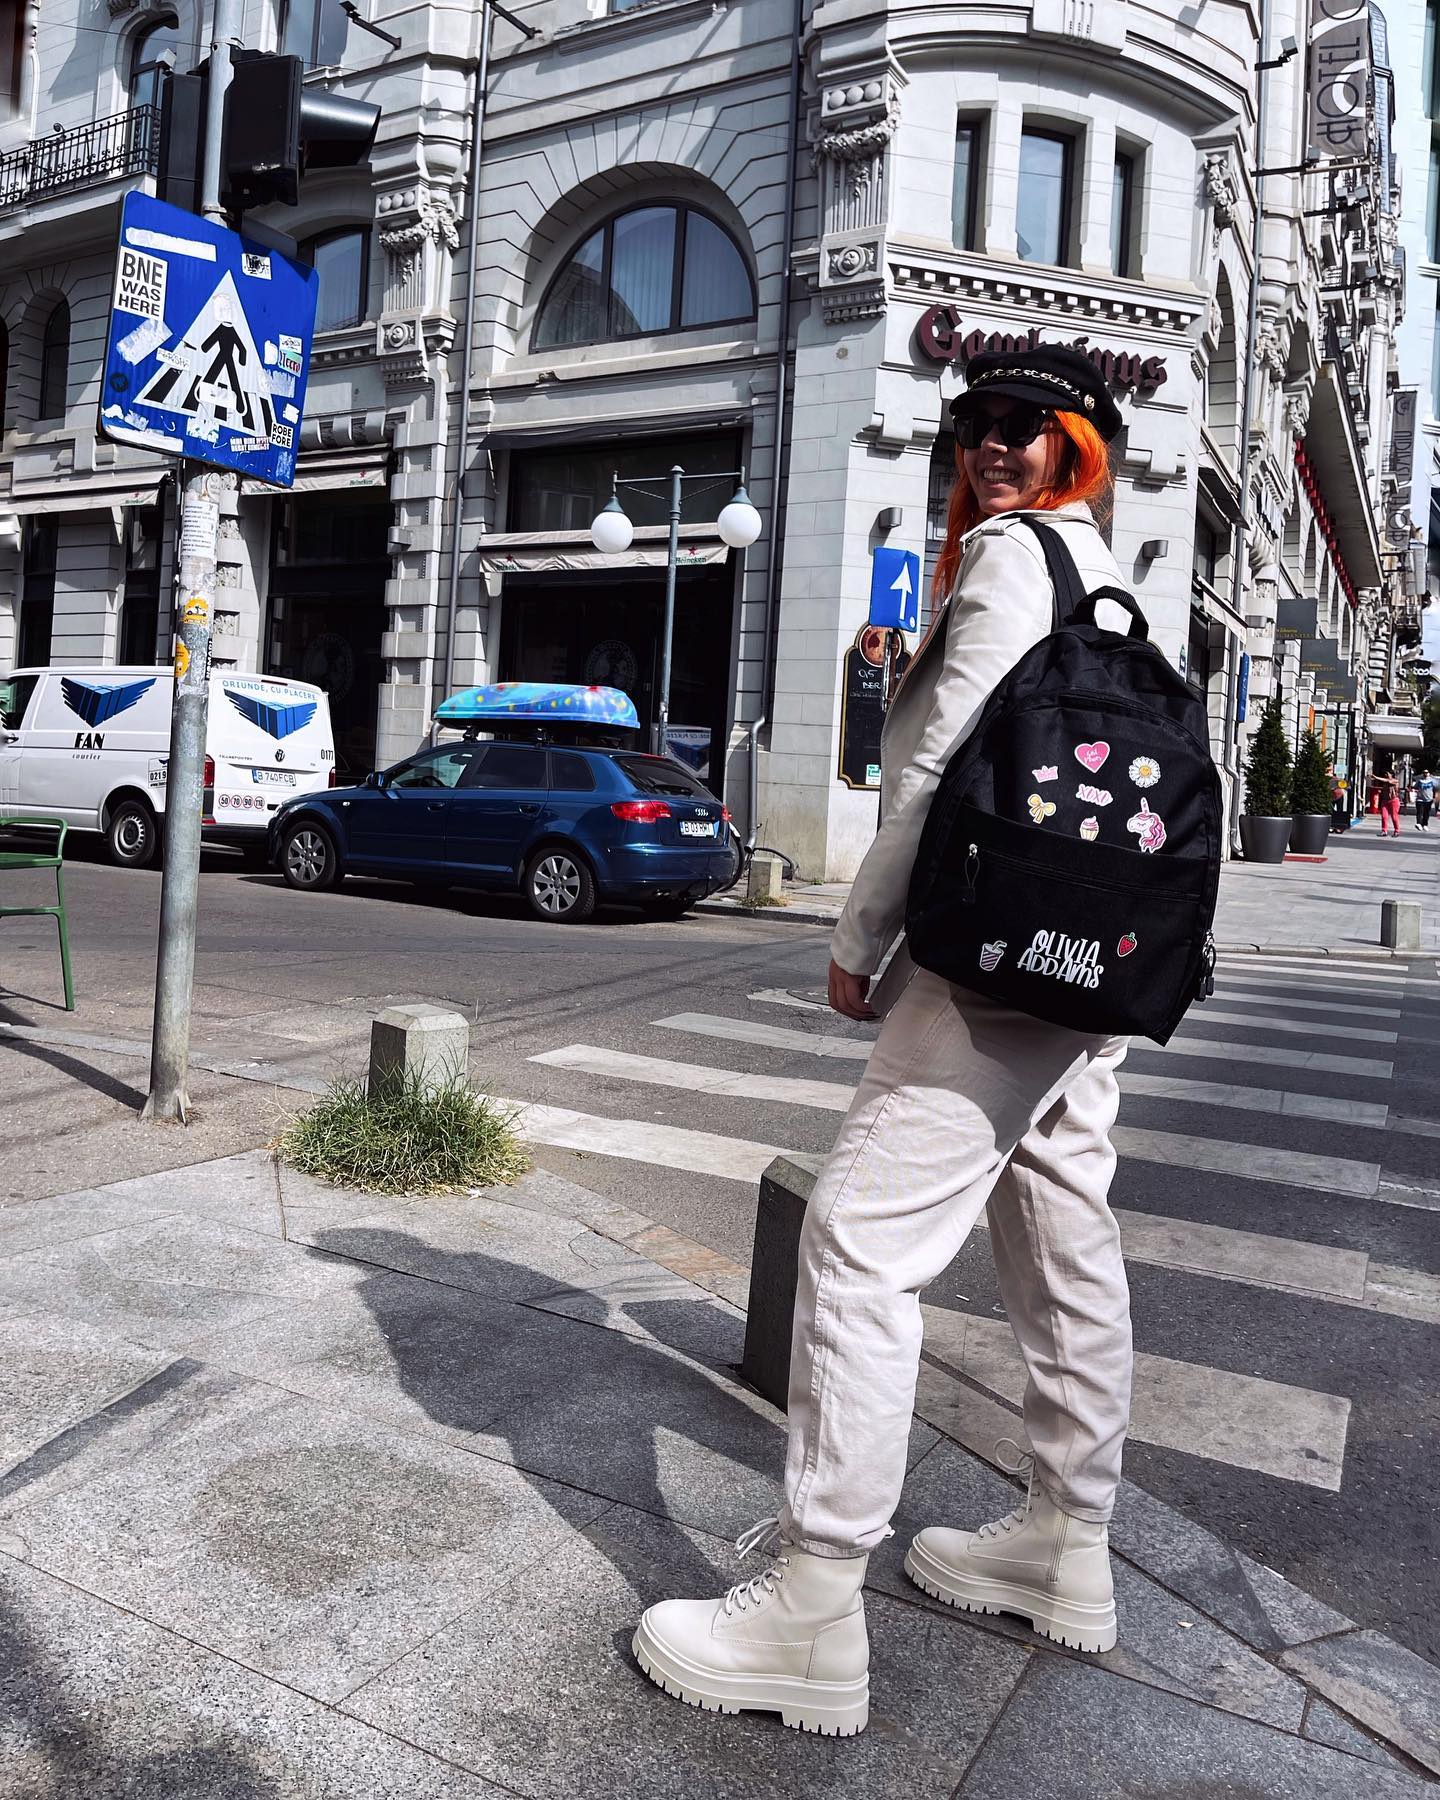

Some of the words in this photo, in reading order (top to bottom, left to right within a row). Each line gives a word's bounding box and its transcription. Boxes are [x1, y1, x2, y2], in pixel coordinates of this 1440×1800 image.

[1316, 36, 1363, 145] HOTEL
[122, 252, 163, 288] BNE
[121, 279, 161, 302] WAS
[118, 293, 161, 317] HERE
[916, 303, 1168, 388] Gamnus
[272, 424, 292, 438] ROBE
[271, 434, 291, 447] FORE
[675, 555, 707, 563] Heineken
[222, 680, 269, 693] ORIUNDE,
[270, 686, 281, 694] CU
[74, 733, 105, 749] FAN
[220, 796, 229, 805] 50
[233, 797, 241, 806] 70
[244, 797, 252, 806] 90
[1031, 929, 1101, 967] OLIVIA
